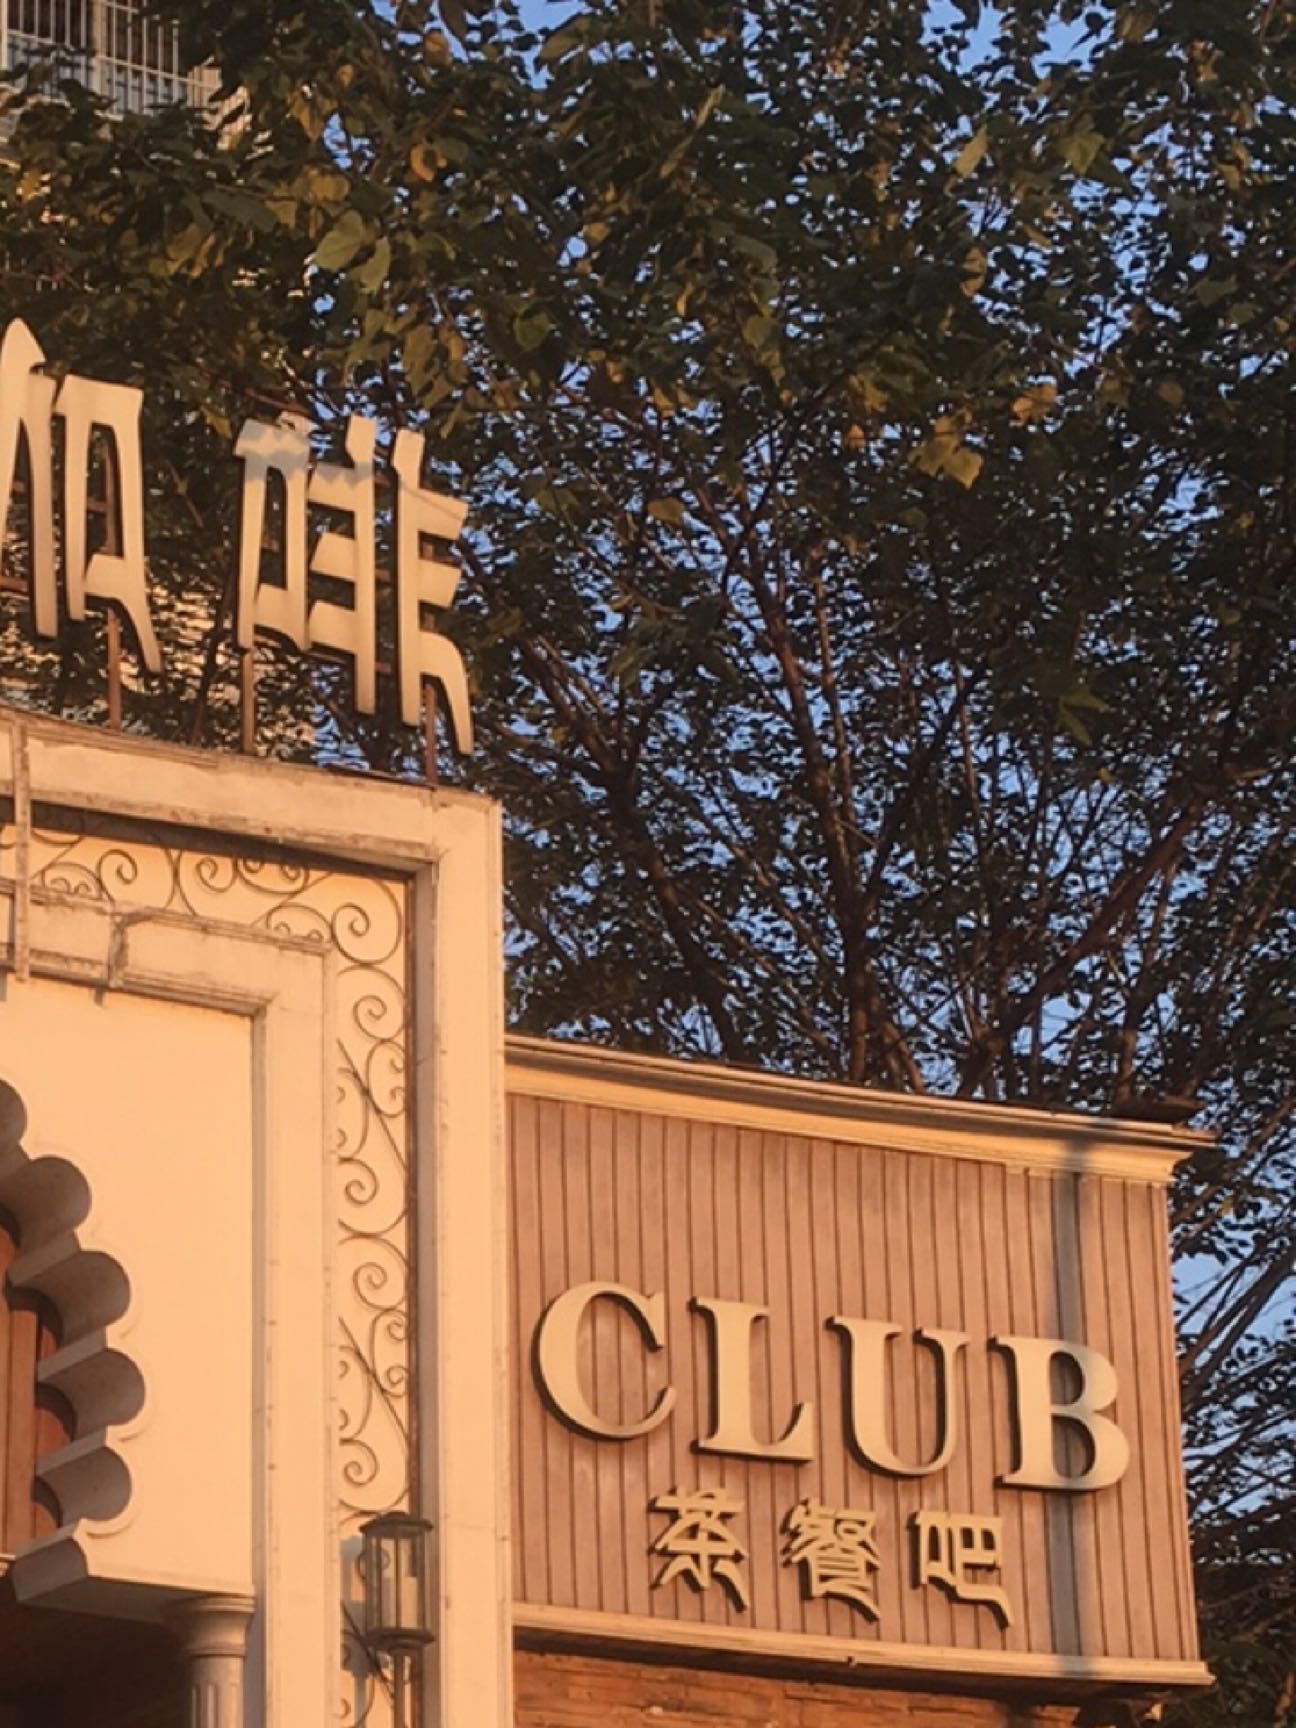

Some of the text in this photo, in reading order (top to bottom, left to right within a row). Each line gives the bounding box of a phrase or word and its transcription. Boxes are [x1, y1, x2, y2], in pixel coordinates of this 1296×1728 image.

[532, 1281, 1131, 1491] CLUB
[650, 1486, 1014, 1627] 茶餐吧
